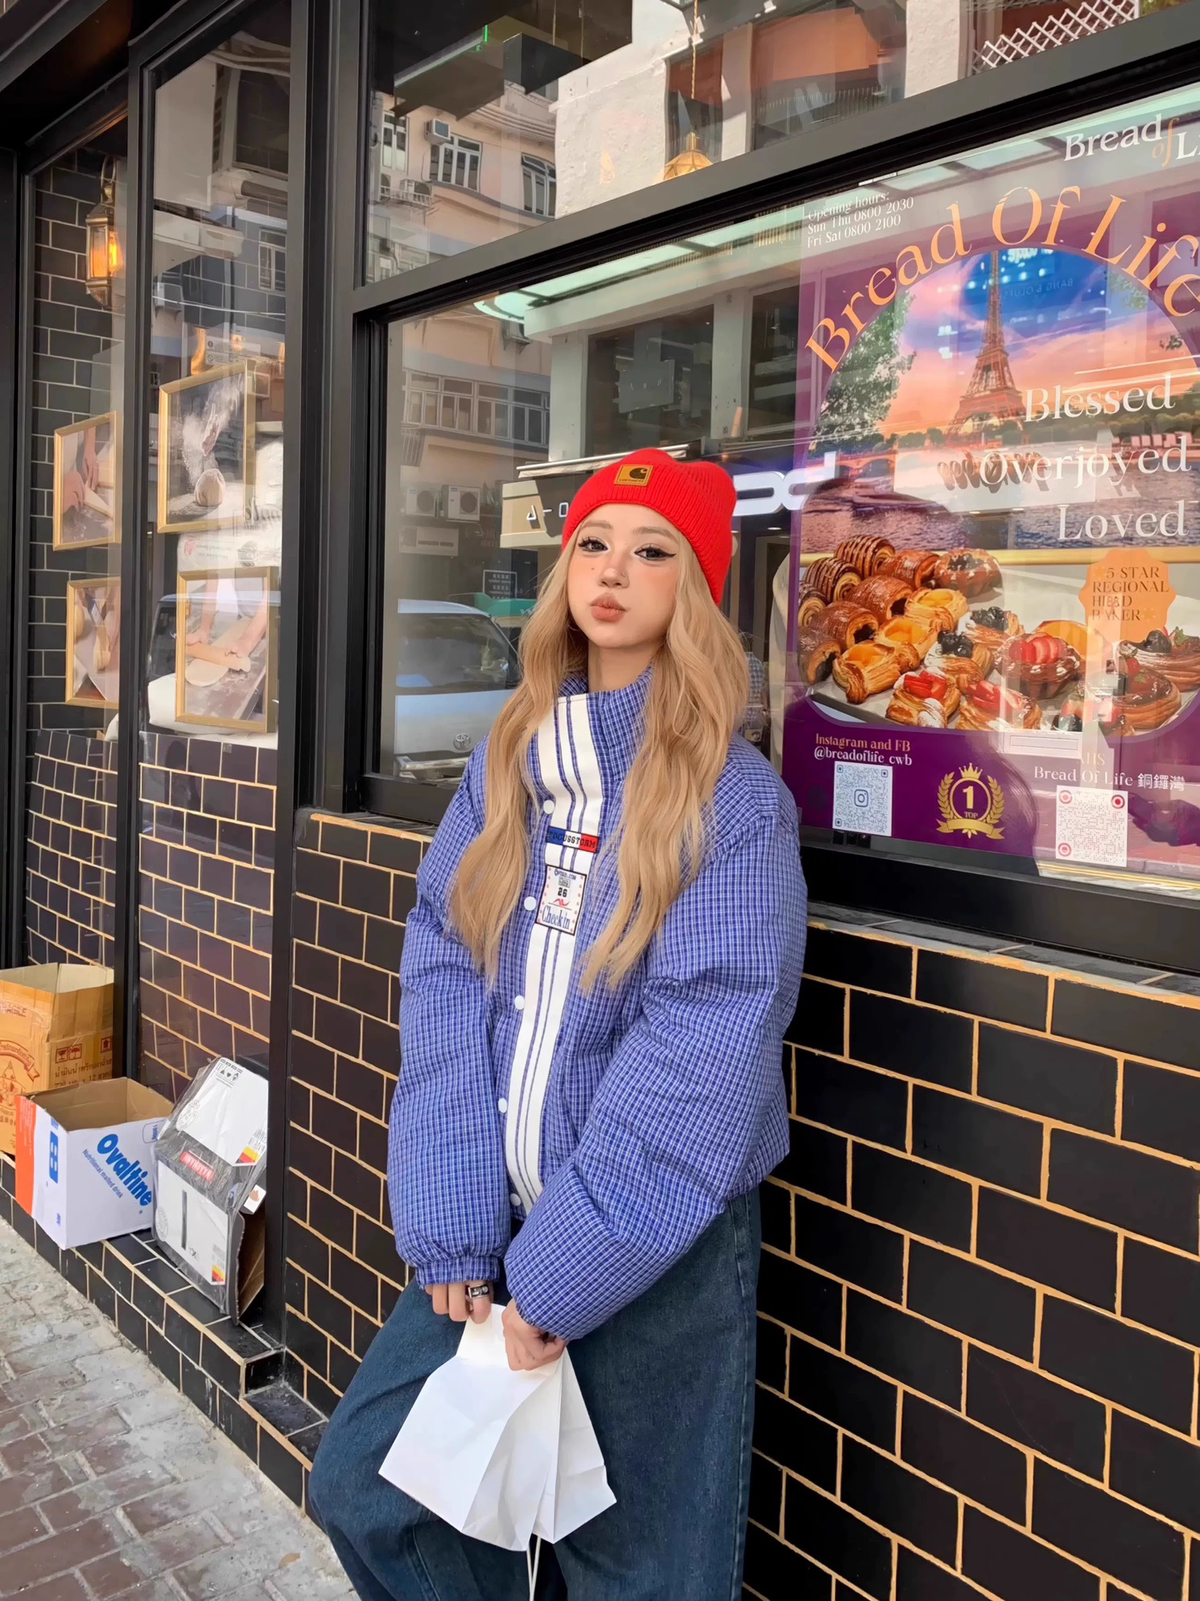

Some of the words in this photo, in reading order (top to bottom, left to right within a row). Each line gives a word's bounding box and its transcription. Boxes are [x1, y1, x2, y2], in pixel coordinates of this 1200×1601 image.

[1064, 113, 1163, 161] Bread
[1152, 117, 1179, 167] of
[807, 223, 826, 235] Sun
[832, 214, 851, 228] Thu
[853, 206, 882, 222] 0800
[885, 196, 914, 215] 2030
[808, 200, 852, 222] Opening
[855, 192, 890, 209] hours:
[807, 234, 822, 249] Fri
[825, 230, 841, 244] Sat
[844, 221, 871, 239] 0800
[875, 214, 902, 231] 2100
[804, 201, 972, 374] Bread
[991, 185, 1081, 246] Of
[1081, 194, 1200, 317] Life
[1023, 372, 1176, 423] Blessed
[979, 435, 1192, 489] Overjoyed
[1056, 499, 1190, 541] Loved
[1092, 581, 1170, 593] REGIONAL
[1106, 567, 1115, 579] 5
[1120, 566, 1160, 579] STAR
[815, 733, 868, 750] Instagram
[870, 739, 891, 751] and
[895, 740, 911, 752] FB
[1034, 765, 1078, 782] Bread
[1081, 769, 1101, 783] Of
[1104, 771, 1134, 787] Life
[1137, 772, 1186, 792] 銅鑼灣
[962, 786, 974, 809] 1
[557, 887, 568, 898] 26
[96, 1133, 152, 1207] Ovaltine
